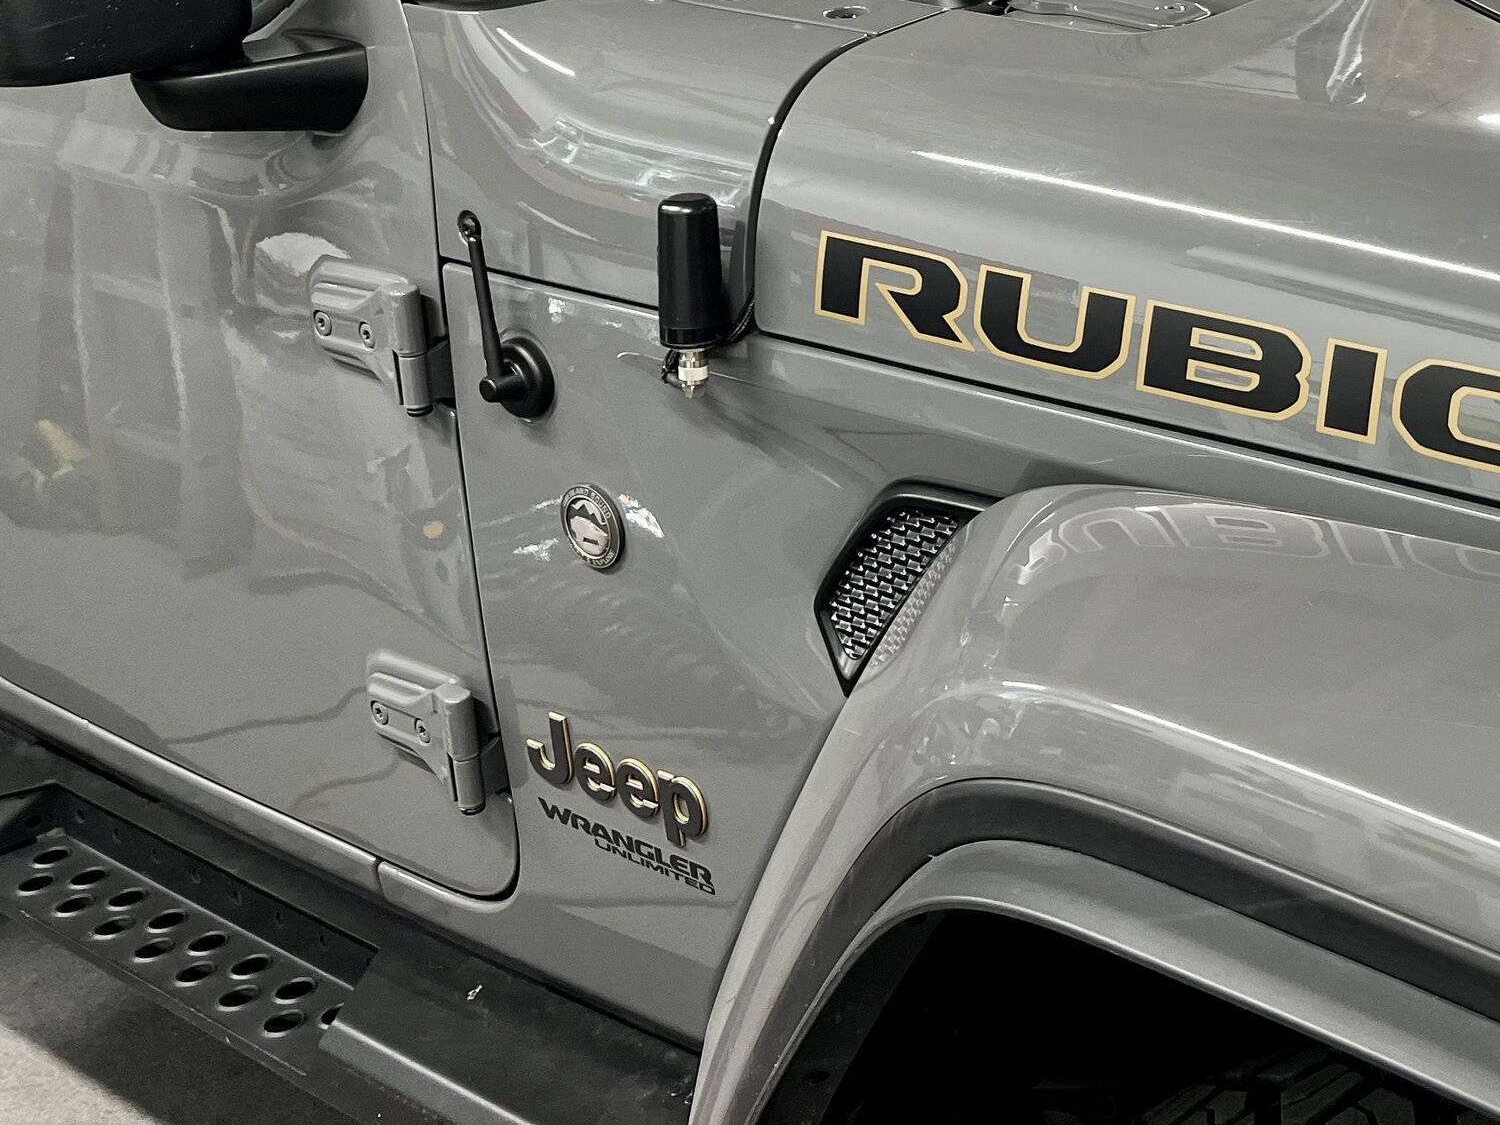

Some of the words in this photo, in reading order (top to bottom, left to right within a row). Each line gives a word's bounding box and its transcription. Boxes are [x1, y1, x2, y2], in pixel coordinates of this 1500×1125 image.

[526, 711, 708, 848] Jeep
[538, 796, 715, 887] WRANGLER
[594, 838, 716, 896] UNLIMITED
